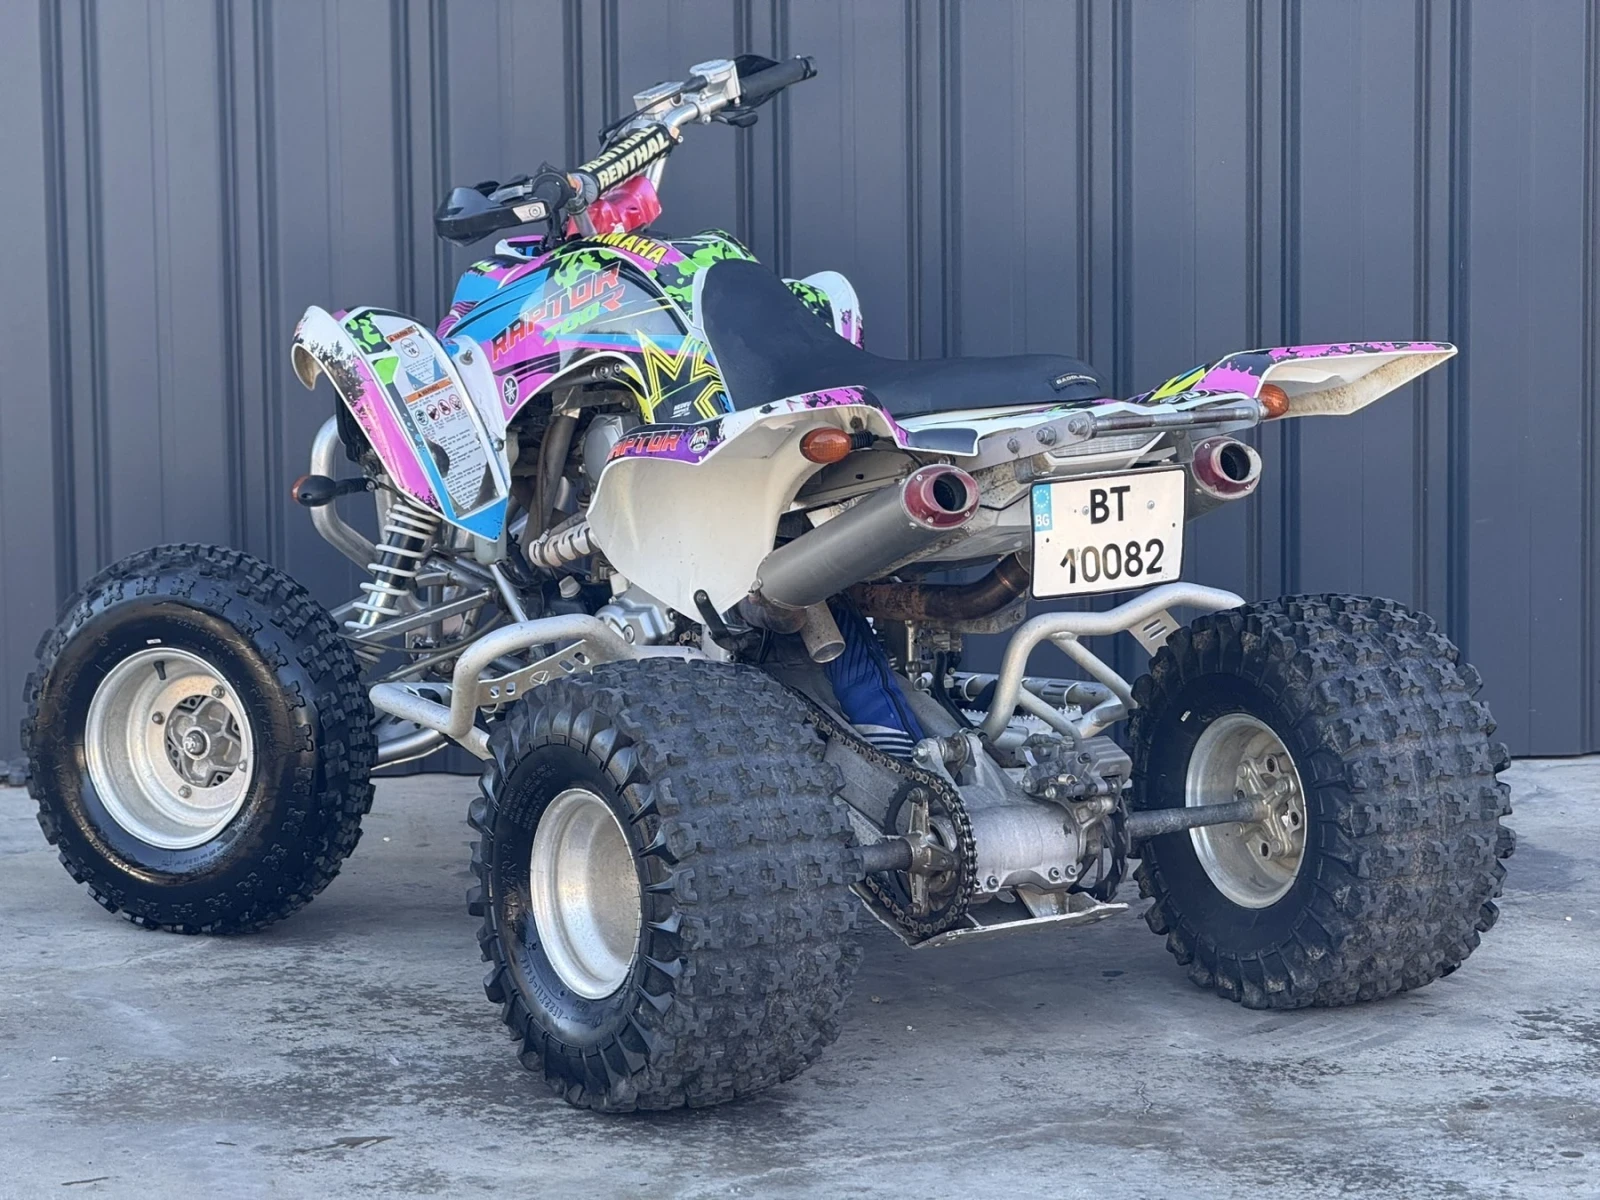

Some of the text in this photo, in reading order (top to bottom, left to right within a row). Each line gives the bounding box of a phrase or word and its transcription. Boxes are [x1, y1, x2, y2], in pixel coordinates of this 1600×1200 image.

[596, 132, 670, 190] RENTHAL
[490, 261, 621, 364] RAPTOR
[1035, 513, 1050, 527] BG
[1090, 485, 1131, 525] BT
[1060, 538, 1164, 584] 10082
